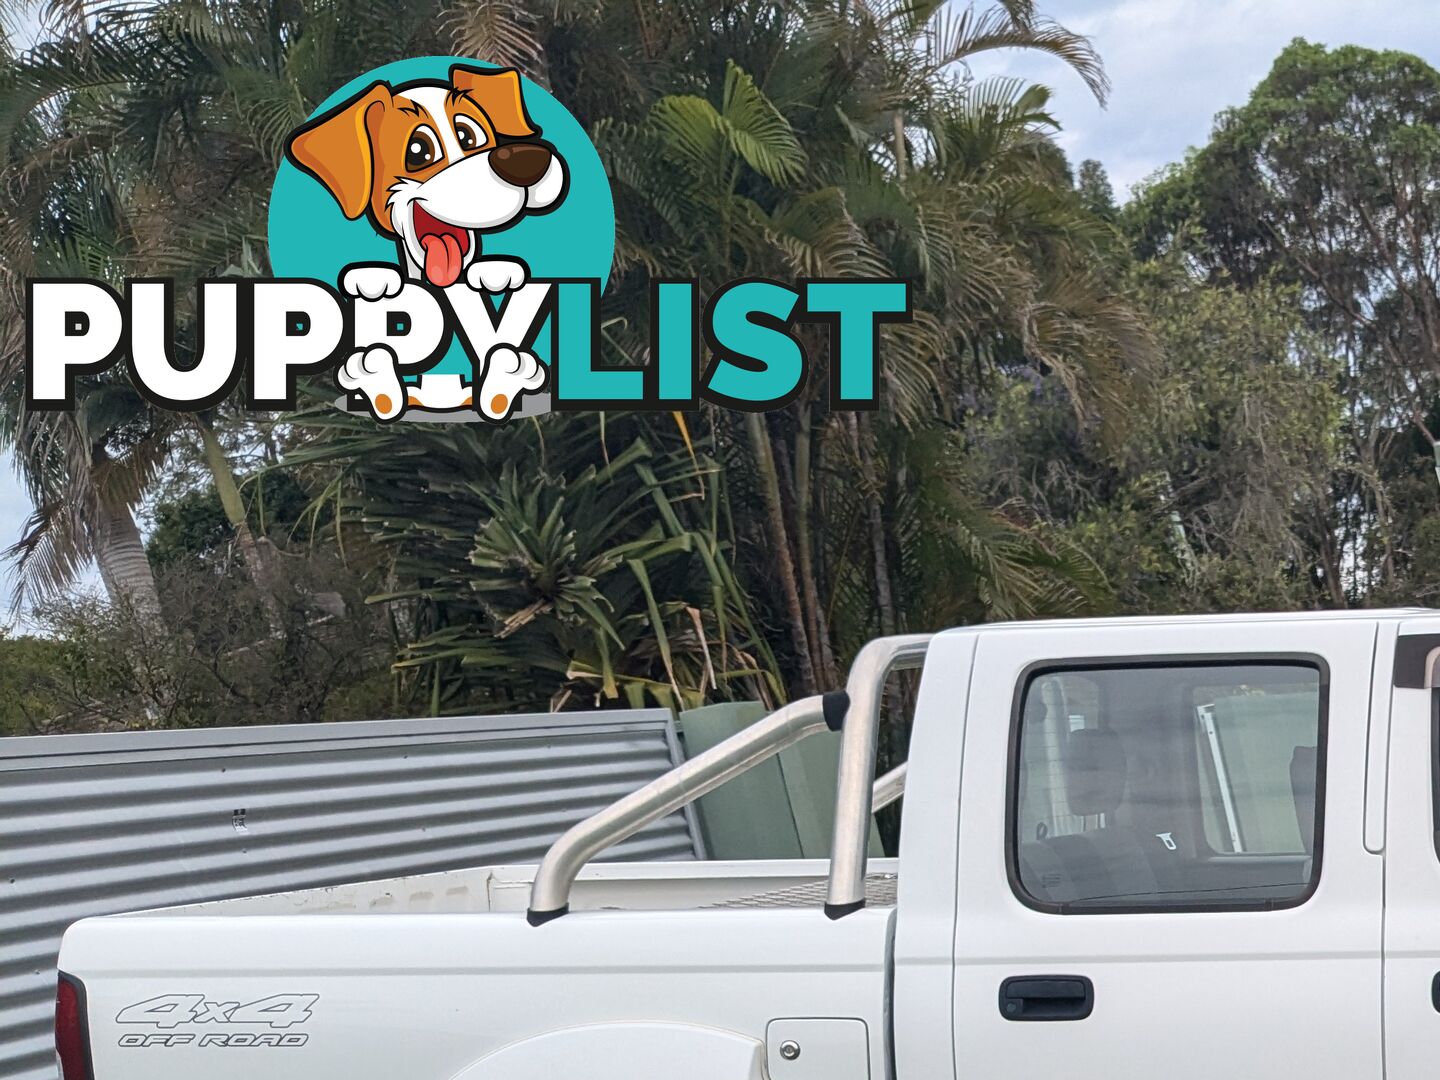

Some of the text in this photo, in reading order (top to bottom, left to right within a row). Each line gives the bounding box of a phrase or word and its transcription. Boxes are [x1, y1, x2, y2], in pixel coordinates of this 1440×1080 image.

[116, 993, 320, 1028] 4x4
[118, 1033, 309, 1047] OFF ROAD
